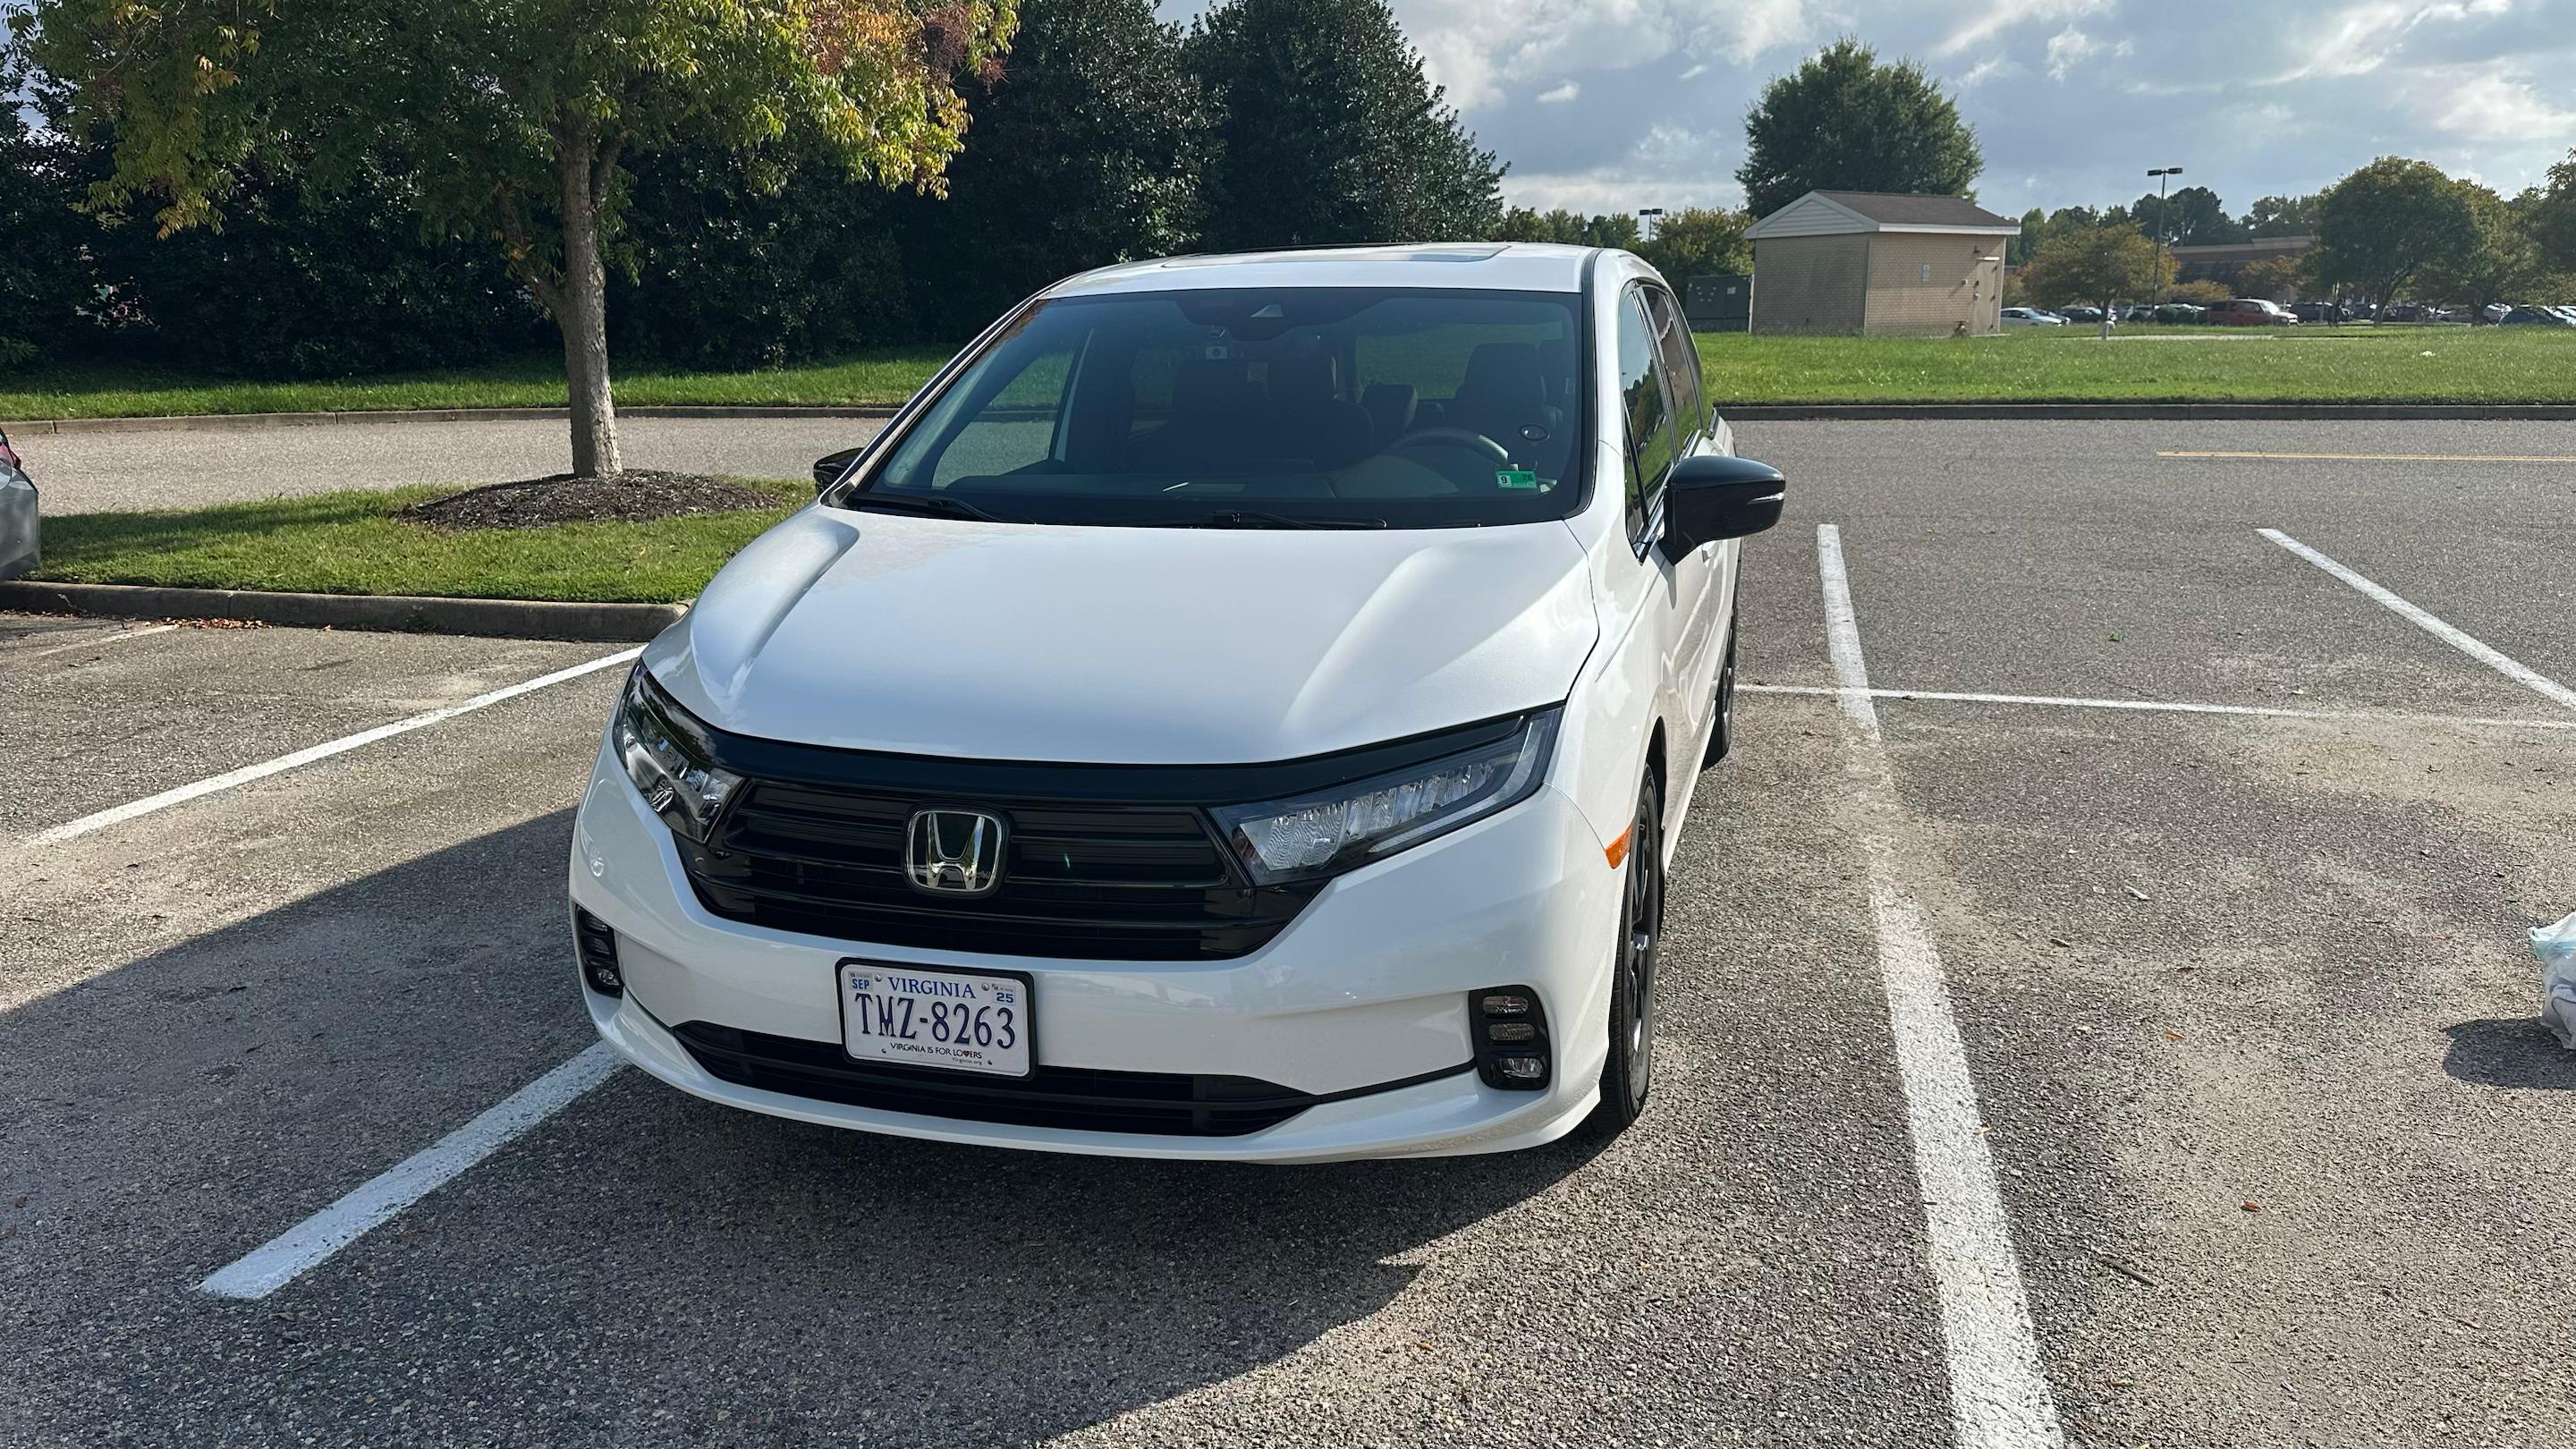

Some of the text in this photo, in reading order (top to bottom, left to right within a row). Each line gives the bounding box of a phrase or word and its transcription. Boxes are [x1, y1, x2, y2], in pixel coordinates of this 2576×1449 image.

[1501, 476, 1507, 484] 9
[852, 979, 869, 990] SEP
[887, 977, 977, 999] VIRGINIA
[996, 992, 1014, 1004] 25
[854, 993, 1016, 1049] TMZ-8263
[890, 1042, 926, 1054] VIRGINIA
[936, 1047, 952, 1056] FOR
